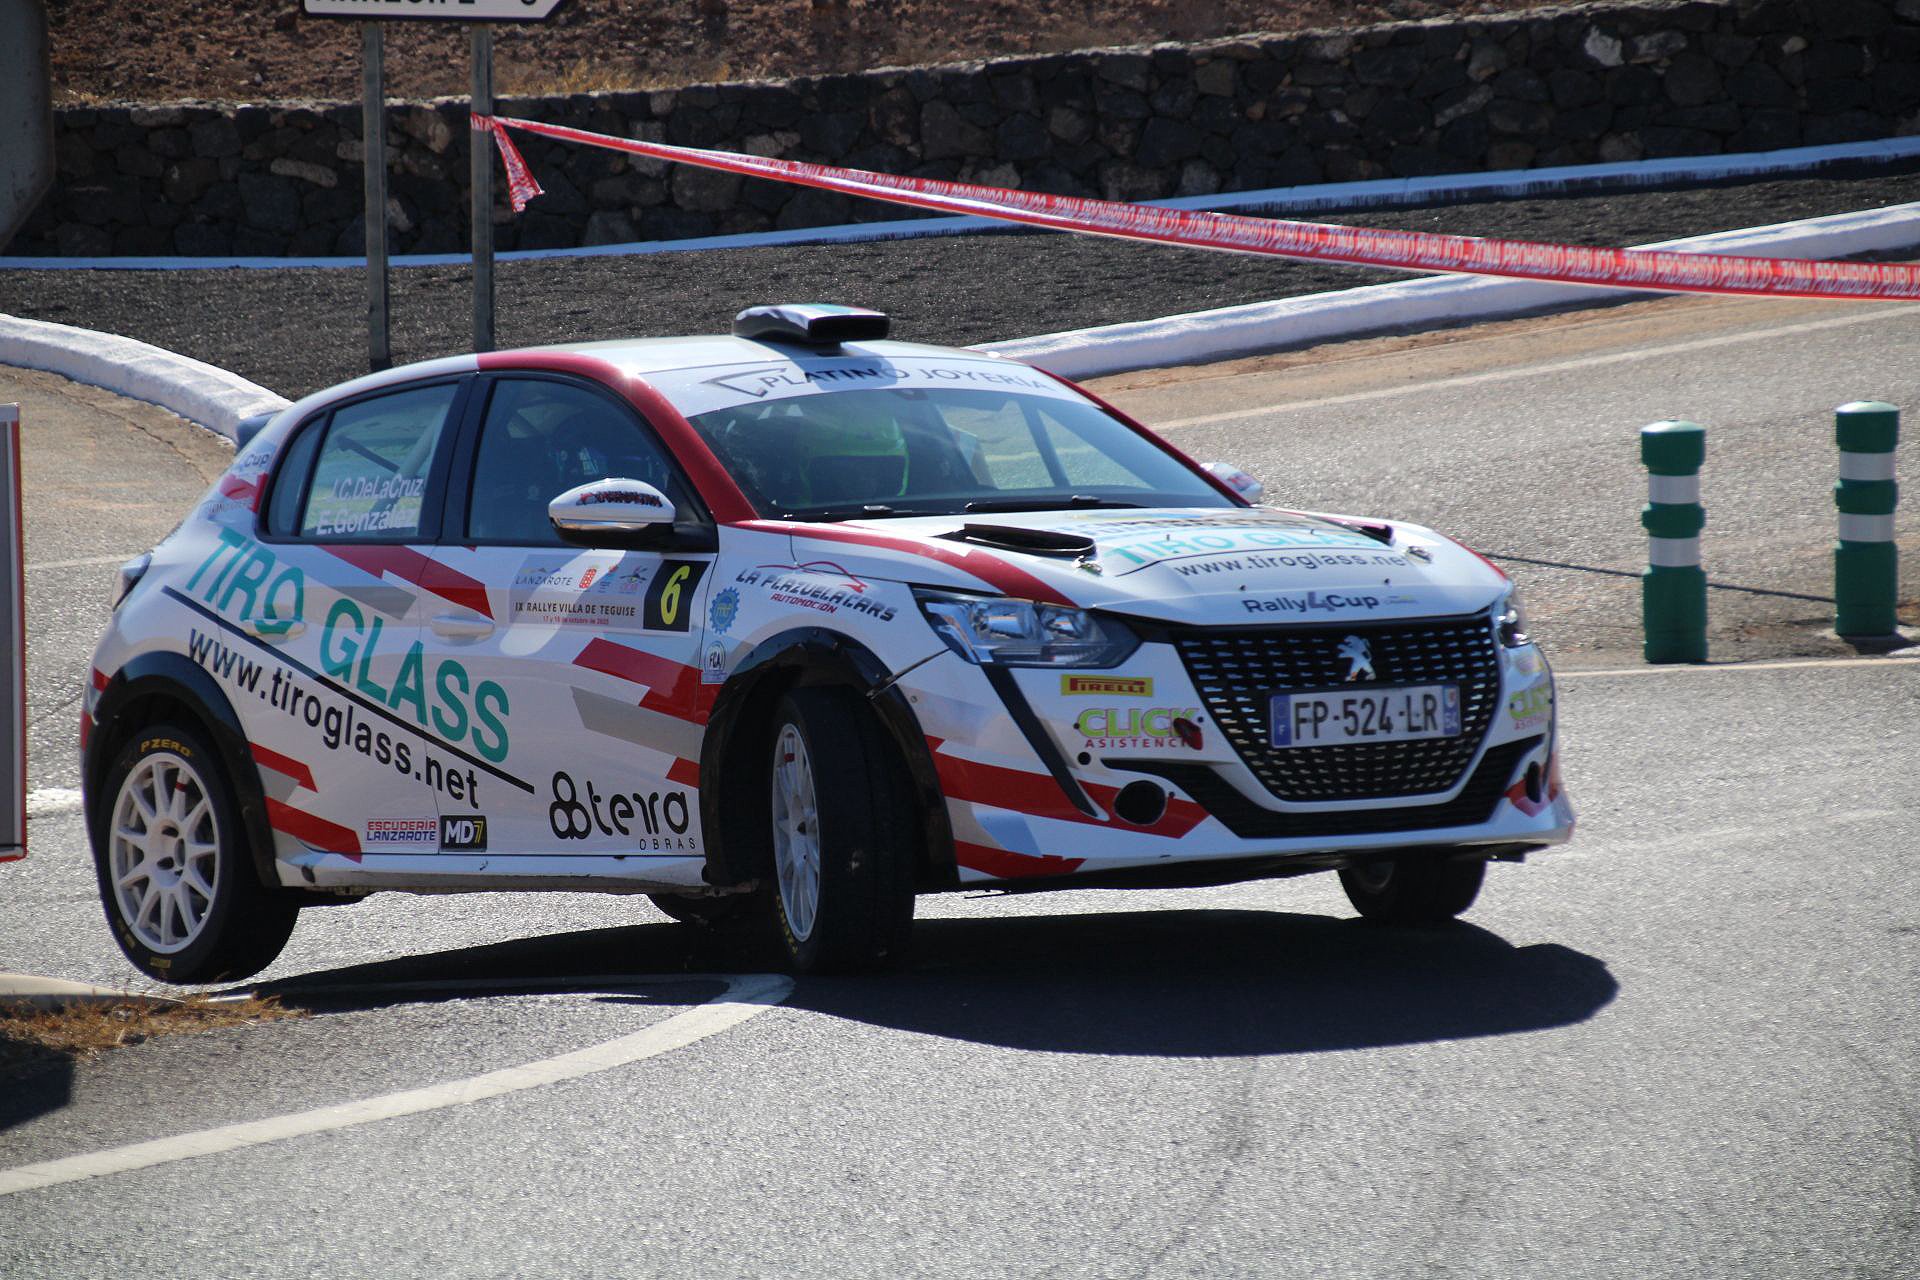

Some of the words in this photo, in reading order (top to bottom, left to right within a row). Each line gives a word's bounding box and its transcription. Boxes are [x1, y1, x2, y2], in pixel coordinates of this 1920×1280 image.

[759, 368, 908, 390] PLATINO
[1105, 534, 1236, 565] TIRO
[736, 568, 757, 585] LA
[660, 565, 691, 625] 6
[515, 602, 524, 612] IX
[526, 602, 558, 613] RALLYE
[559, 603, 583, 614] VILLA
[585, 604, 597, 615] DE
[600, 605, 636, 617] TEGUISE
[185, 526, 305, 634] TIRO
[319, 598, 510, 763] GLASS
[1069, 677, 1147, 694] PIRELLI
[187, 628, 480, 810] www.tiroglass.net
[366, 830, 437, 842] LANZAROTE
[443, 819, 483, 845] MD7
[639, 837, 696, 851] OBRAS
